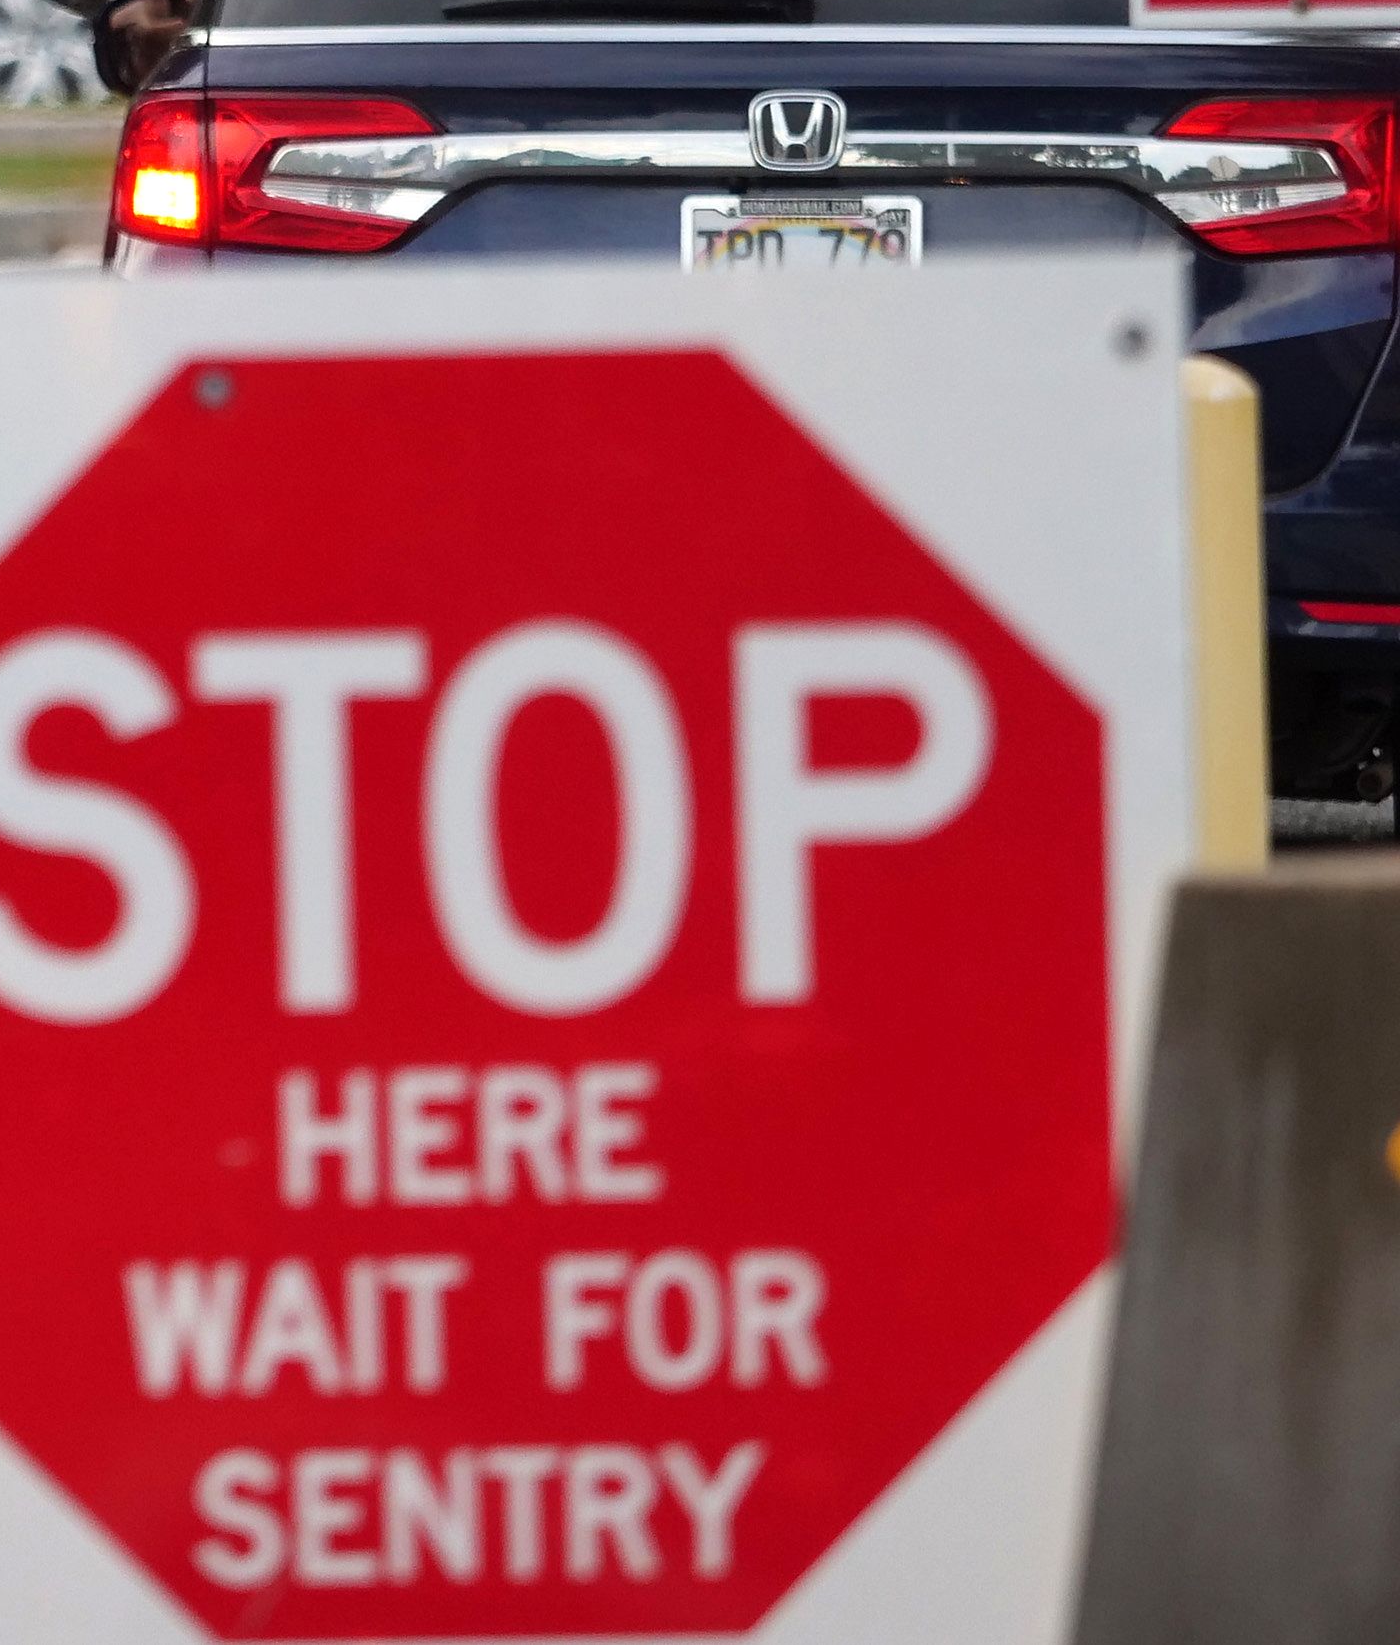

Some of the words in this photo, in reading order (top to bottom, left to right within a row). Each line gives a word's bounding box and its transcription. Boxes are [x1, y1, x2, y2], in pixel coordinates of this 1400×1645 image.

[276, 1061, 667, 1207] HERE
[124, 1254, 472, 1397] WAIT
[541, 1247, 830, 1393] FOR
[191, 1440, 769, 1590] SENTRY
